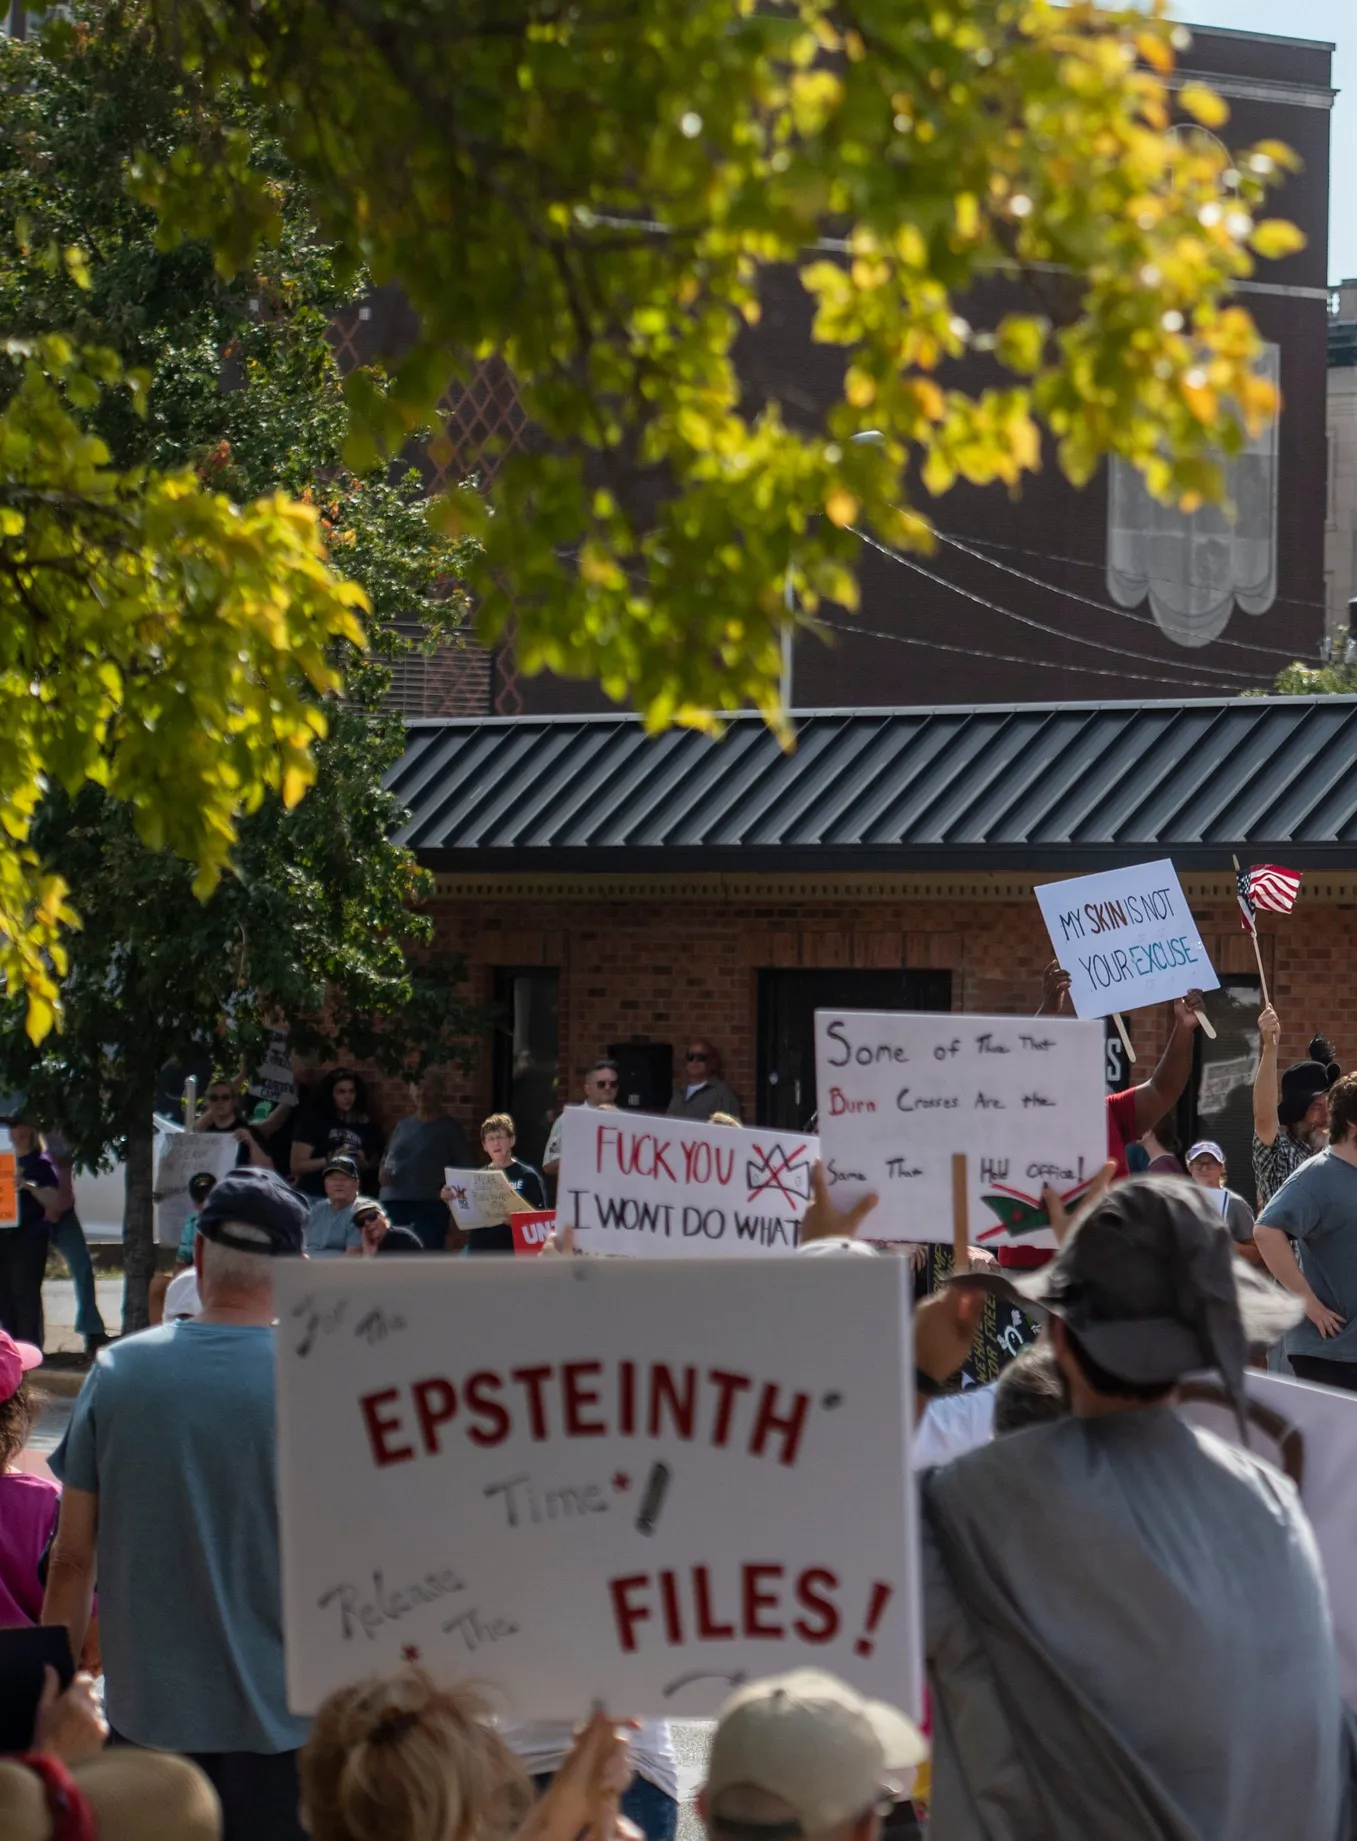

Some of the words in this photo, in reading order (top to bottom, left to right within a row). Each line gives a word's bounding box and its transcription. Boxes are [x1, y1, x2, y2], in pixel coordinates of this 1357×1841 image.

[1059, 909, 1086, 941] MY
[1084, 899, 1128, 934] SKIN
[1123, 896, 1144, 925] IS
[1140, 888, 1175, 922] NOT
[1078, 949, 1135, 990] YOUR
[1128, 936, 1199, 976] EXCUSE
[826, 1020, 910, 1068] Some
[933, 1038, 962, 1061] of
[827, 1086, 877, 1117] Burn
[896, 1088, 960, 1112] Crosses
[973, 1091, 1006, 1109] Are
[595, 1125, 677, 1184] FUCK
[679, 1140, 735, 1185] YOU
[566, 1190, 592, 1230] I
[593, 1193, 675, 1238] WONT
[682, 1206, 726, 1240] DO
[733, 1211, 803, 1250] WHAT
[359, 1360, 812, 1468] EPSTEINTH
[318, 1567, 466, 1642] Release
[609, 1561, 893, 1659] FILES!
